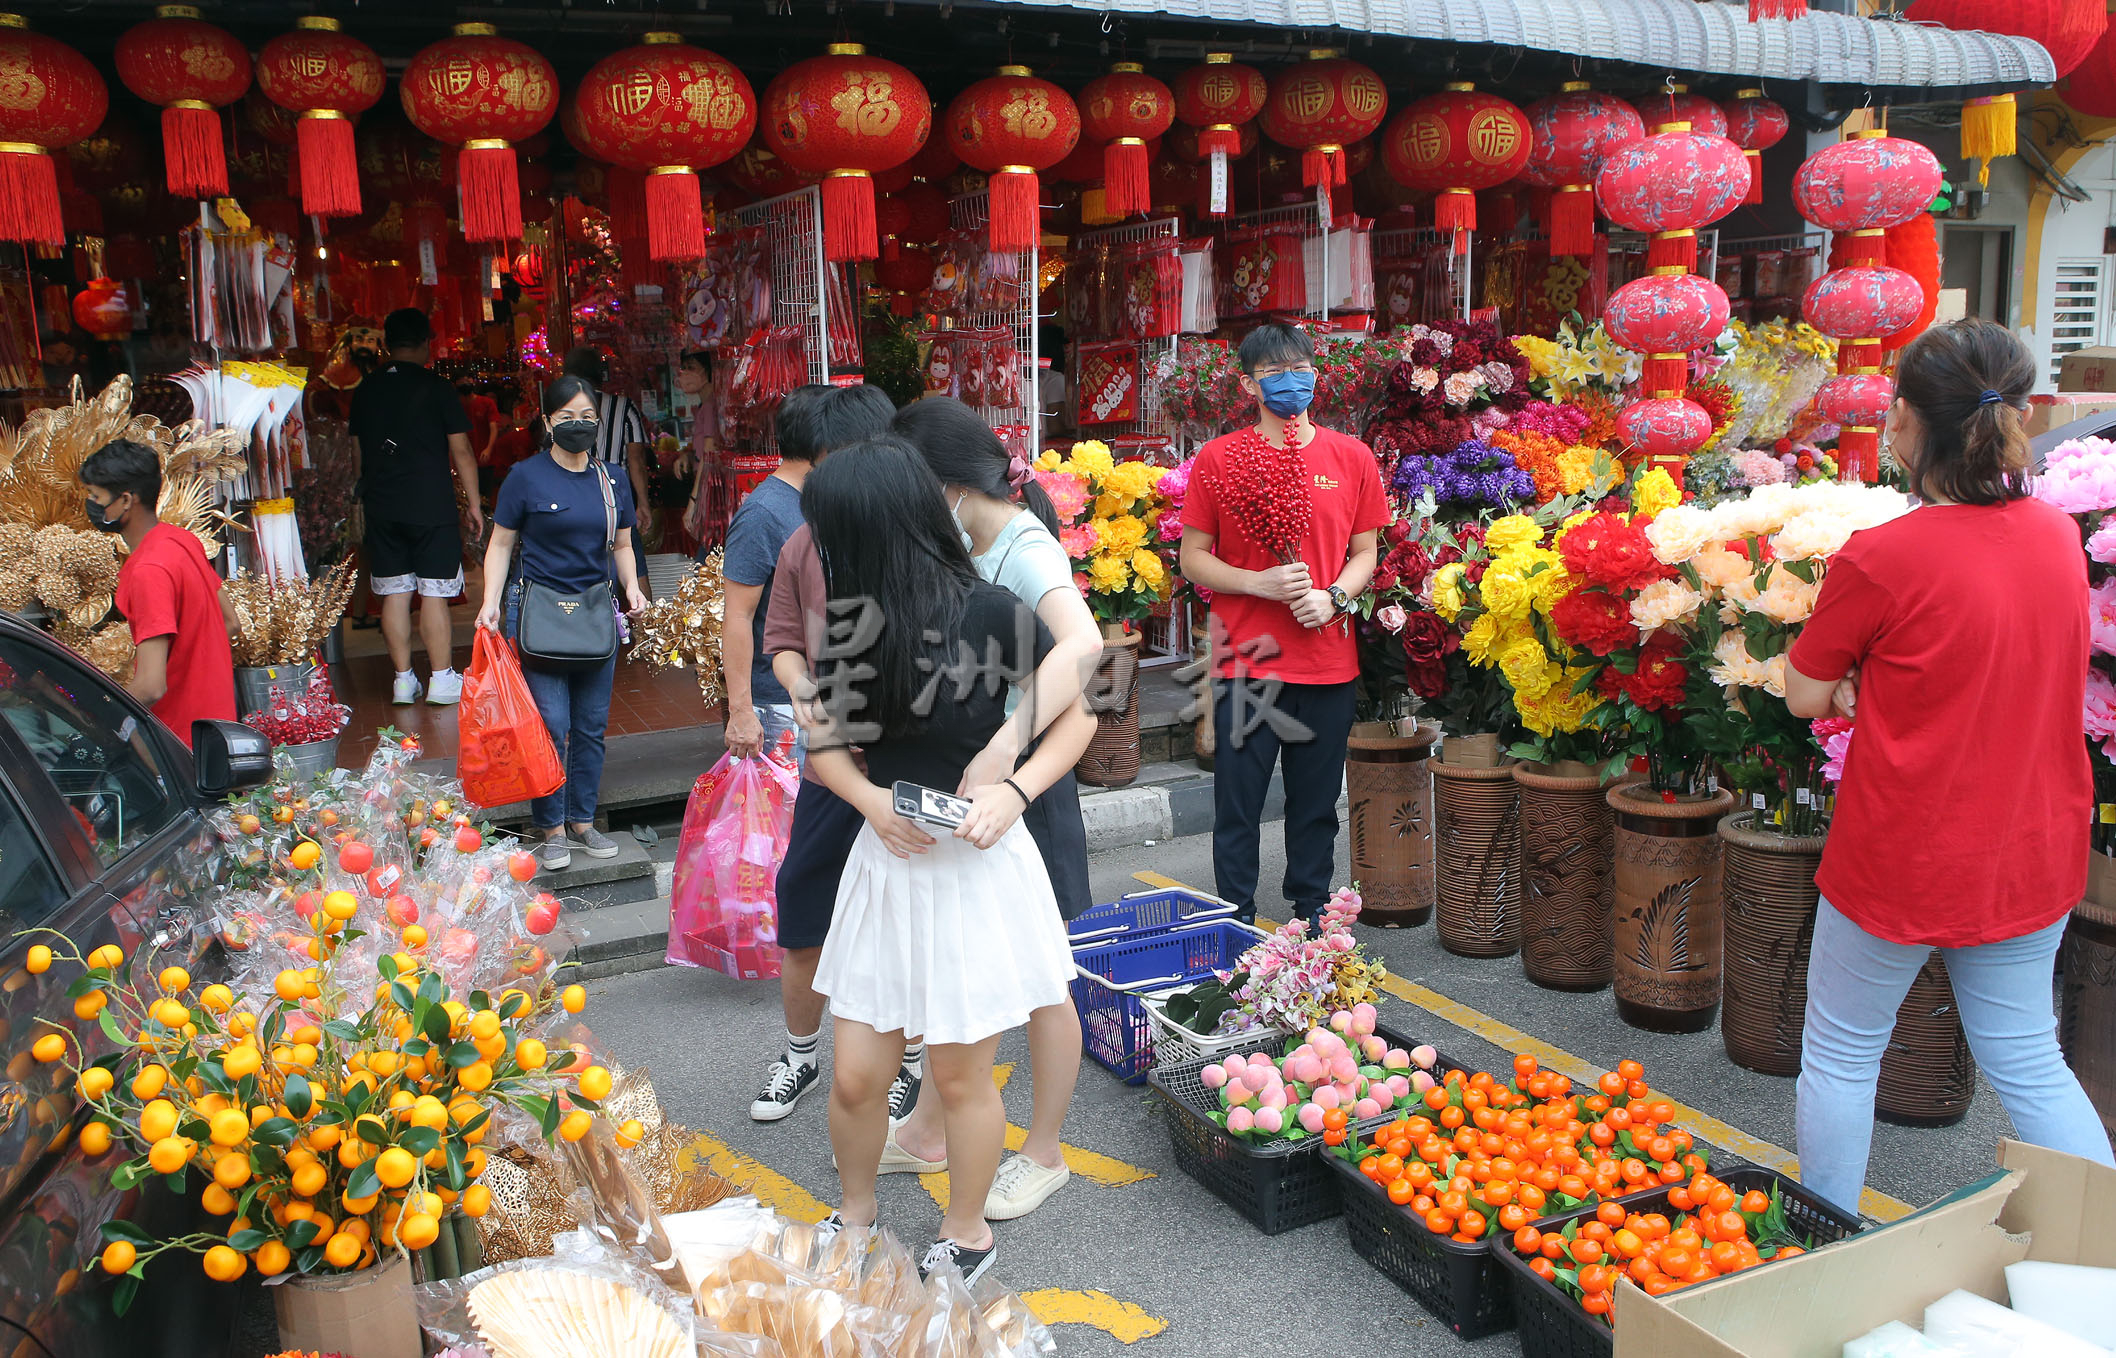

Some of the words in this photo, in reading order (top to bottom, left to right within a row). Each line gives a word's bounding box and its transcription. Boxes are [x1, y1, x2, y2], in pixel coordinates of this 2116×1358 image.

[429, 54, 473, 97] 福
[605, 65, 653, 116] 福
[1203, 74, 1235, 104] 福
[1284, 75, 1326, 118] 福
[1350, 72, 1380, 114] 福
[831, 70, 902, 137] 福
[1000, 86, 1058, 140] 福
[1402, 120, 1441, 164] 福
[1477, 114, 1516, 158] 福
